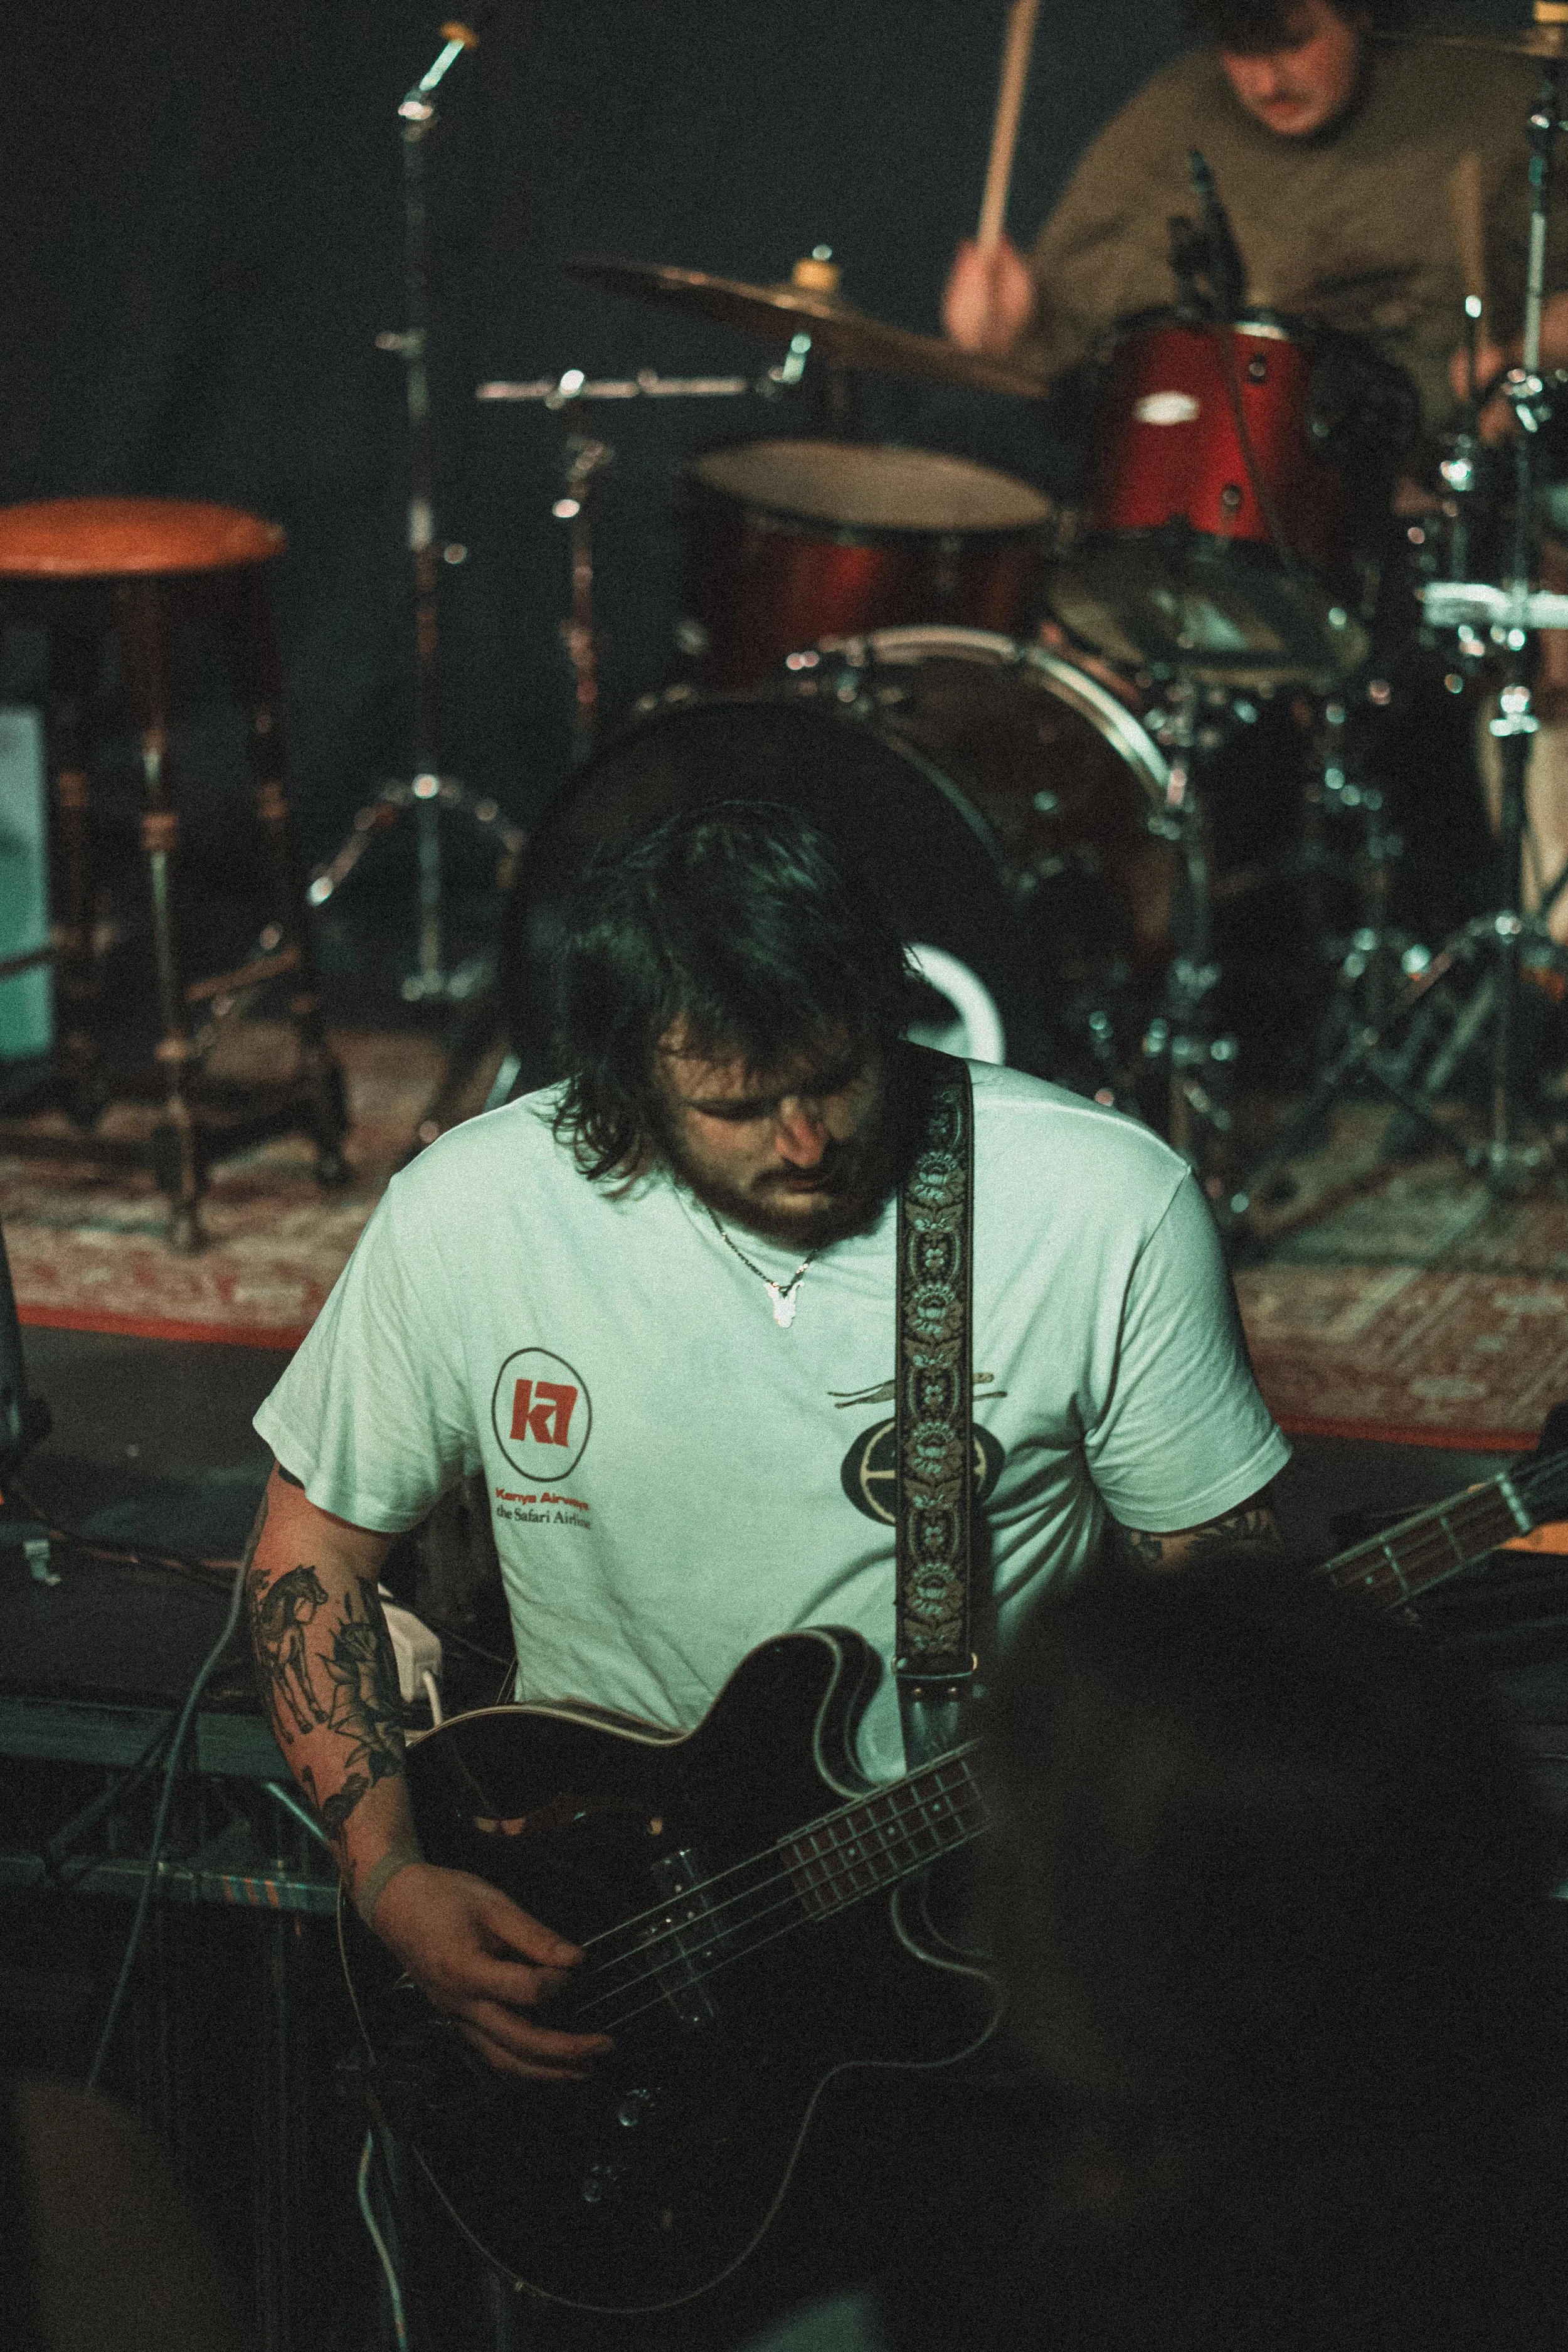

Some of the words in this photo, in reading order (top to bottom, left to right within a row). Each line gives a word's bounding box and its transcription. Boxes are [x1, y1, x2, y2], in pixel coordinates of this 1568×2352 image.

[495, 1487, 537, 1505] Kenya
[496, 1505, 512, 1520] the
[514, 1507, 550, 1523] Safari
[553, 1510, 591, 1530] Airline
